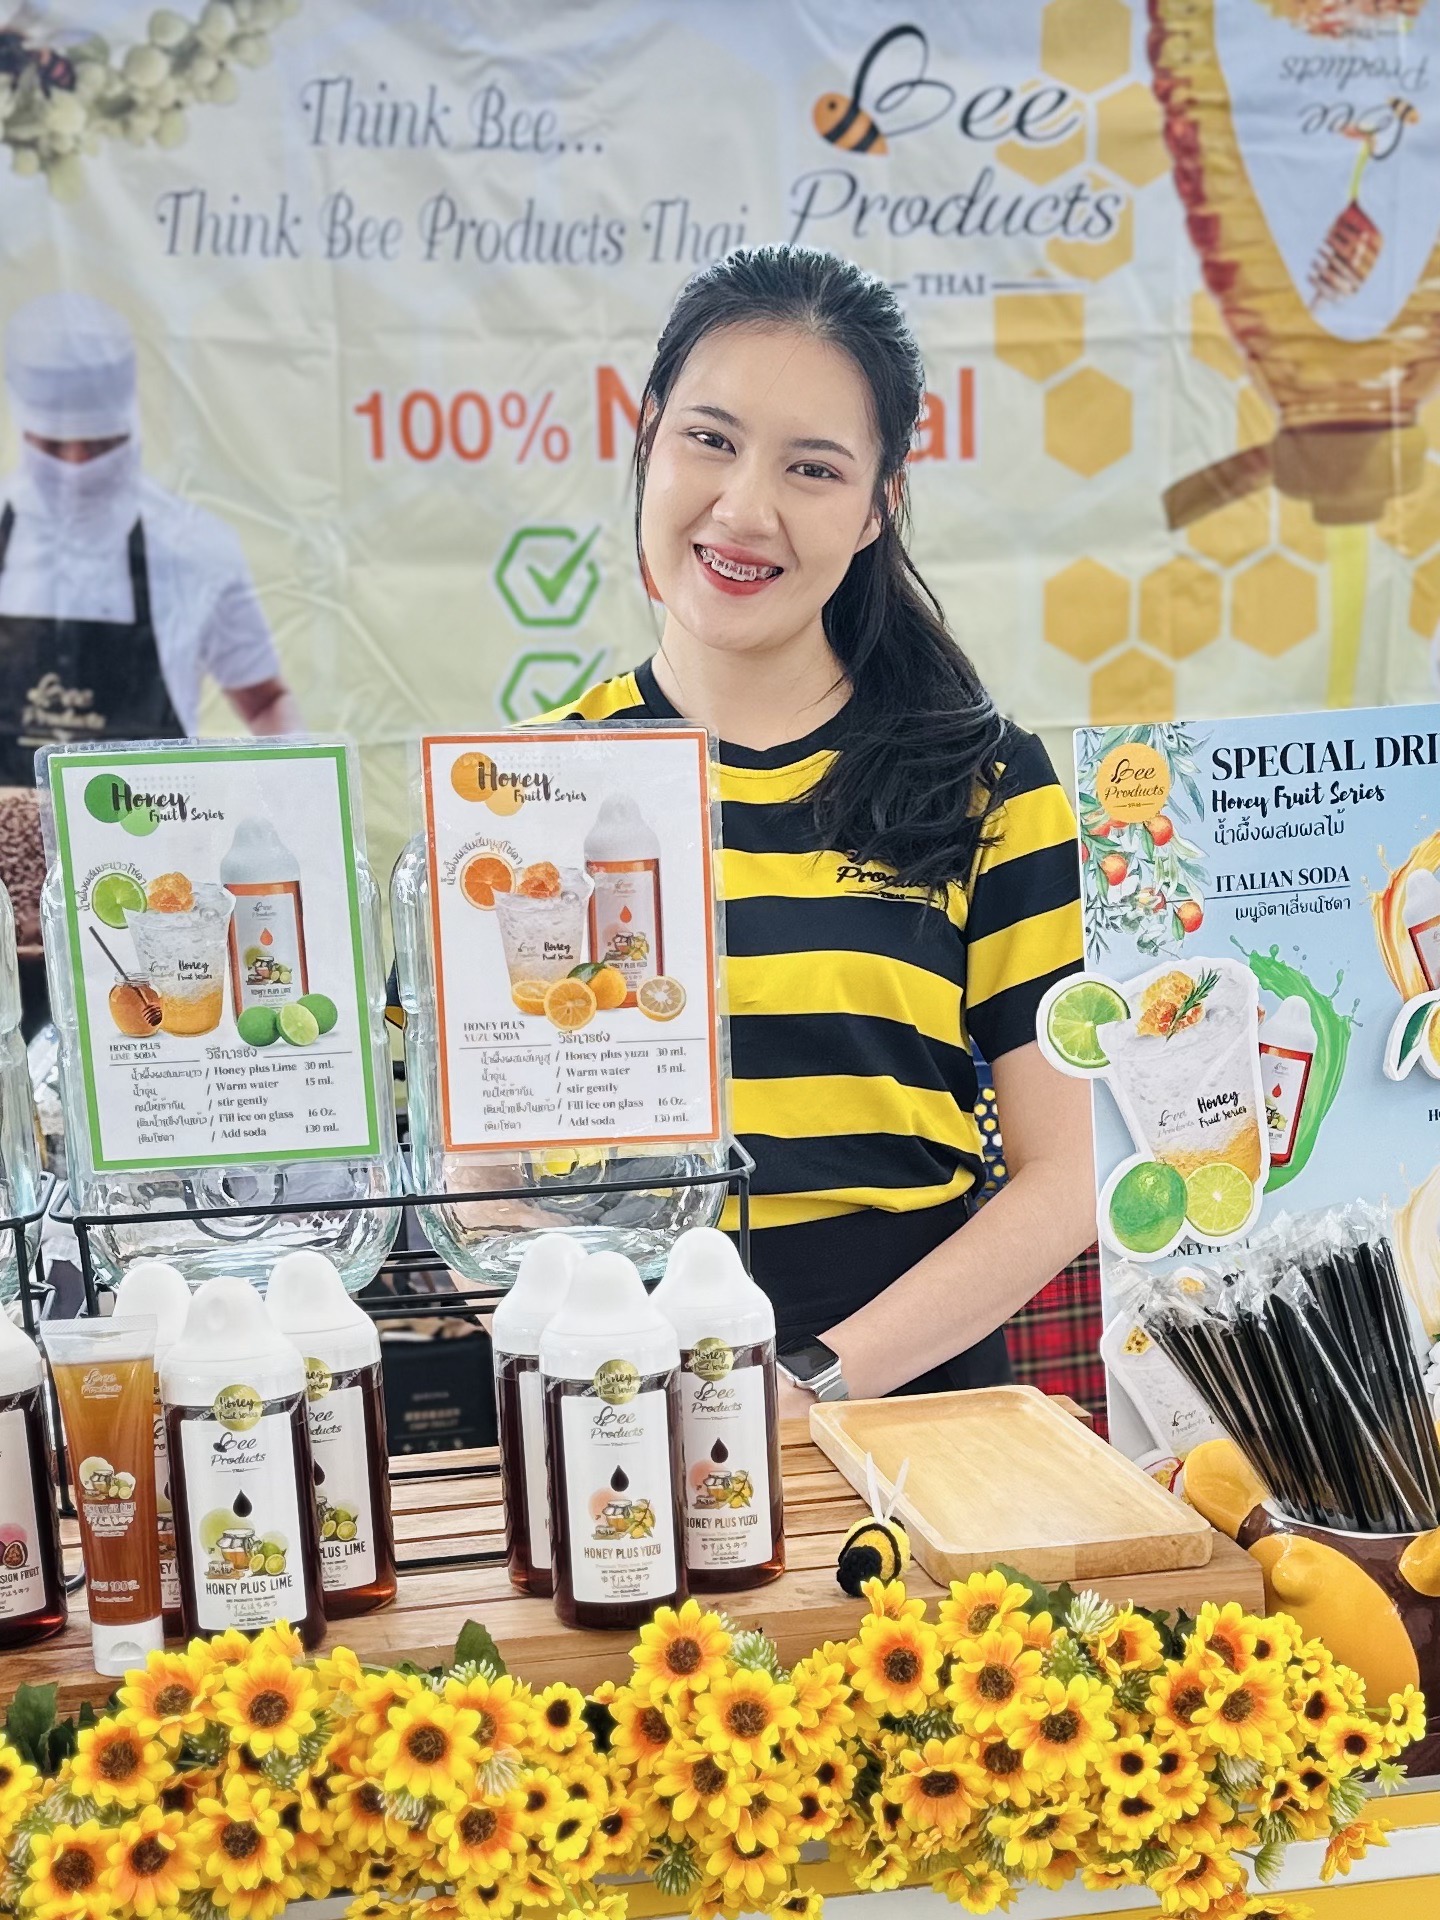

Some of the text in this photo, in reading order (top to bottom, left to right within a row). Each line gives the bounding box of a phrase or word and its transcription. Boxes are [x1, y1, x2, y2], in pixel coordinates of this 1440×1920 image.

[1278, 54, 1430, 93] Products
[822, 22, 1084, 152] Bee
[303, 77, 605, 155] Think Bee...
[1298, 97, 1421, 161] Bee
[789, 167, 1122, 247] Products
[156, 189, 748, 264] Think Bee Products Thai
[912, 274, 986, 297] THAI
[354, 390, 571, 465] 100%
[1211, 732, 1440, 781] SPECIAL DRI
[1110, 758, 1157, 784] Bee
[477, 761, 554, 801] Honey
[513, 789, 588, 804] Fruit Series
[1104, 783, 1165, 801] Products
[1211, 781, 1386, 818] Honey Fruit Series
[110, 782, 190, 820] Honey
[149, 808, 225, 823] Fruit Series
[1214, 808, 1346, 846] น้ำผึ้งผสมผลไม้
[1216, 865, 1350, 893] ITALIAN SODA
[463, 1020, 526, 1032] HONEY PLUS
[492, 1031, 520, 1042] SODA
[109, 1042, 161, 1052] HONEY PLUS
[133, 1050, 157, 1060] SODA
[565, 1051, 598, 1063] Honey
[600, 1050, 622, 1062] plus
[623, 1050, 649, 1062] yuzu
[656, 1047, 668, 1058] 30
[213, 1065, 246, 1077] Honey
[248, 1064, 270, 1075] plus
[271, 1063, 298, 1073] Lime
[304, 1061, 316, 1071] 30
[565, 1067, 599, 1078] Warm
[600, 1066, 631, 1077] water
[656, 1064, 668, 1074] 15
[216, 1080, 248, 1092] Warm
[249, 1079, 280, 1090] water
[304, 1077, 316, 1087] 15
[566, 1083, 585, 1094] stir
[586, 1082, 620, 1096] gently
[217, 1097, 236, 1107] stir
[236, 1095, 270, 1109] gently
[567, 1099, 584, 1111] Fill
[585, 1100, 601, 1110] ice
[602, 1099, 617, 1109] on
[618, 1098, 644, 1111] glass
[658, 1097, 669, 1107] 16
[1196, 1090, 1240, 1114] Honey
[218, 1112, 236, 1124] Fill
[236, 1112, 252, 1122] ice
[253, 1112, 268, 1122] on
[268, 1109, 295, 1121] glass
[308, 1107, 318, 1118] 16
[568, 1115, 590, 1127] Add
[590, 1115, 616, 1127] soda
[653, 1114, 671, 1124] 130
[1198, 1105, 1248, 1128] Fruit Series
[220, 1128, 242, 1140] Add
[243, 1127, 268, 1138] soda
[304, 1124, 321, 1134] 130
[693, 1381, 736, 1402] Bee
[592, 1405, 637, 1427] Bee
[691, 1401, 743, 1414] Products
[590, 1426, 645, 1440] Products
[213, 1431, 258, 1453] Bee
[210, 1452, 267, 1467] Products
[714, 1516, 737, 1529] PLUS
[738, 1514, 758, 1527] YUZU
[344, 1541, 367, 1556] LIME
[584, 1543, 662, 1560] HONEY PLUS YUZU
[20, 1566, 40, 1581] FRUIT
[205, 1574, 294, 1596] HONEY PLUS LIME
